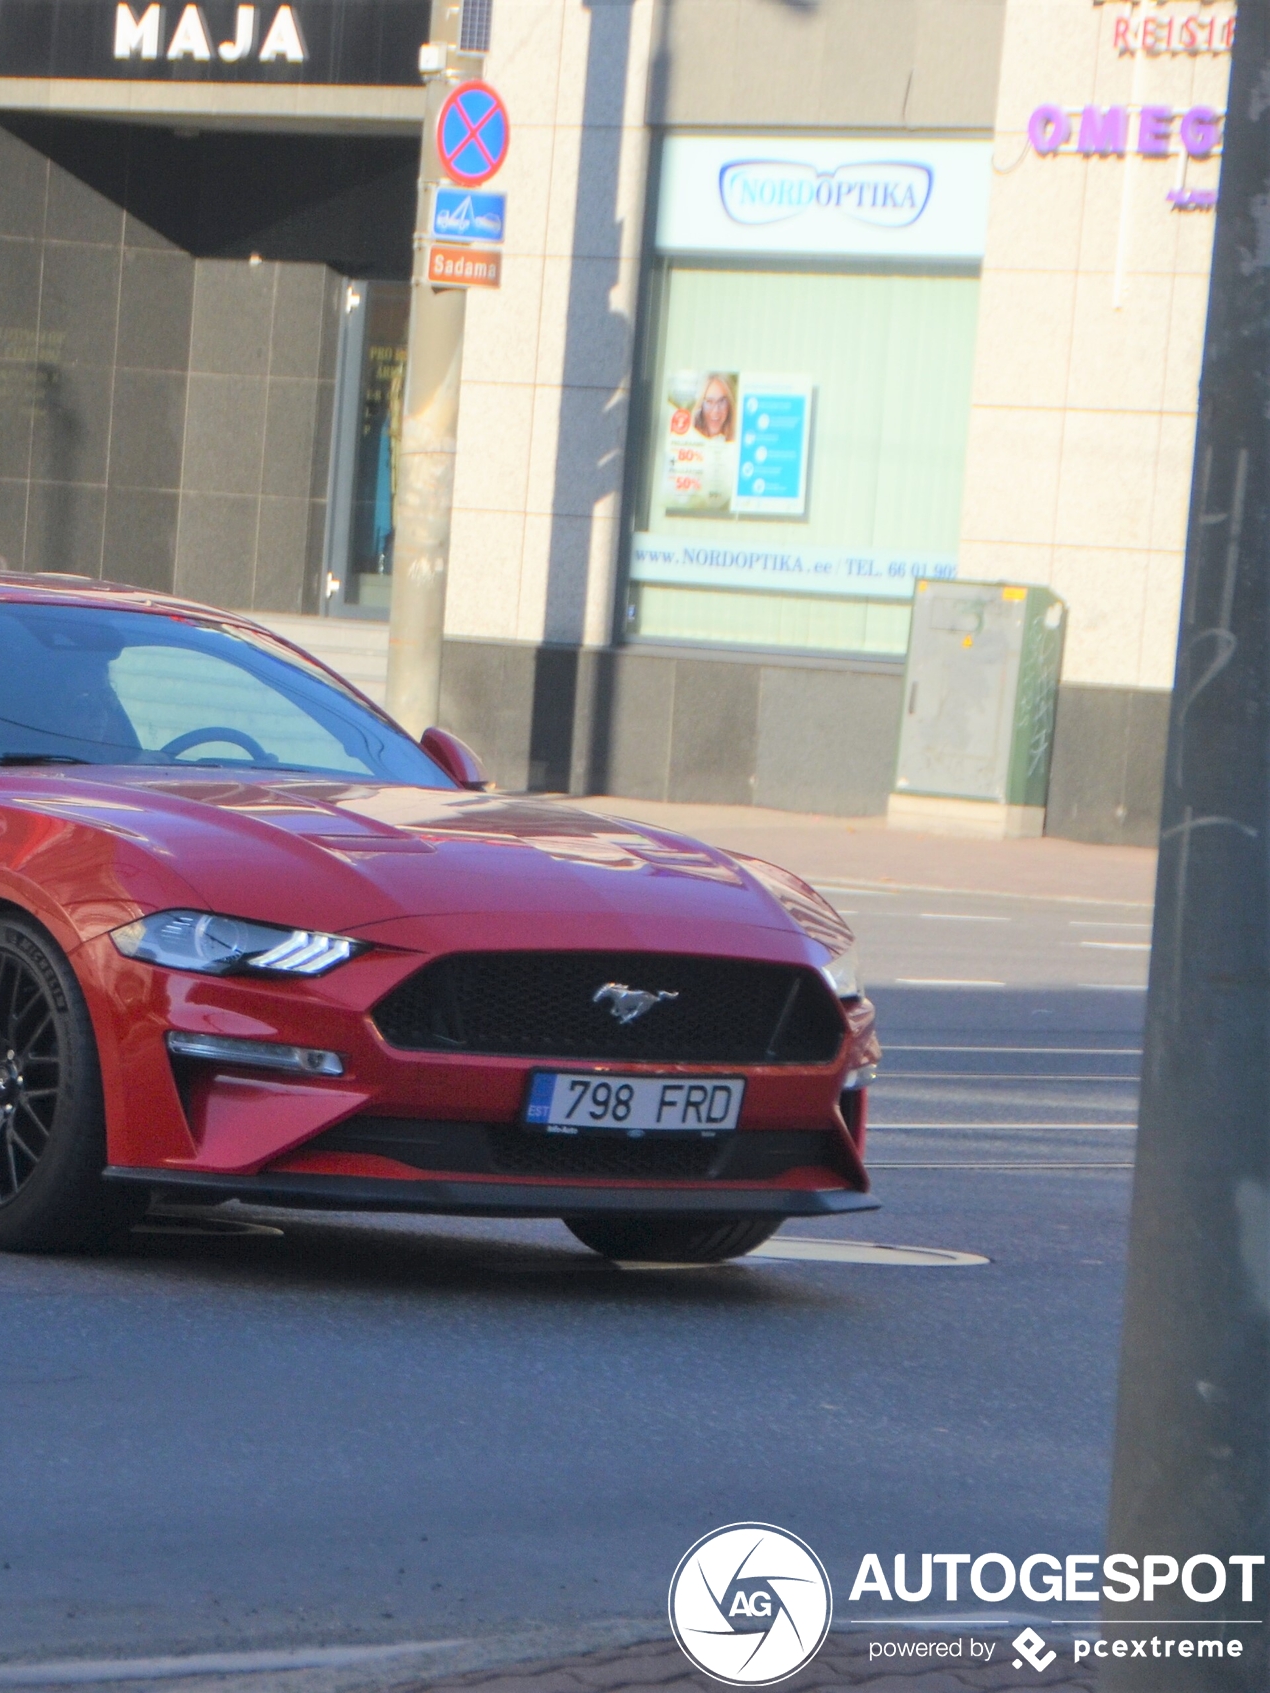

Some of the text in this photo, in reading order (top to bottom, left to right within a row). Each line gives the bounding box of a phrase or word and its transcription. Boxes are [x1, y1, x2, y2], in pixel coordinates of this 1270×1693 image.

[114, 2, 306, 62] MAJA
[739, 178, 918, 209] NORDOPTIKA
[433, 253, 498, 280] Sadama
[846, 558, 883, 578] TEL.
[888, 561, 906, 578] 66
[528, 1105, 550, 1117] EST
[565, 1080, 733, 1124] 798 FRD
